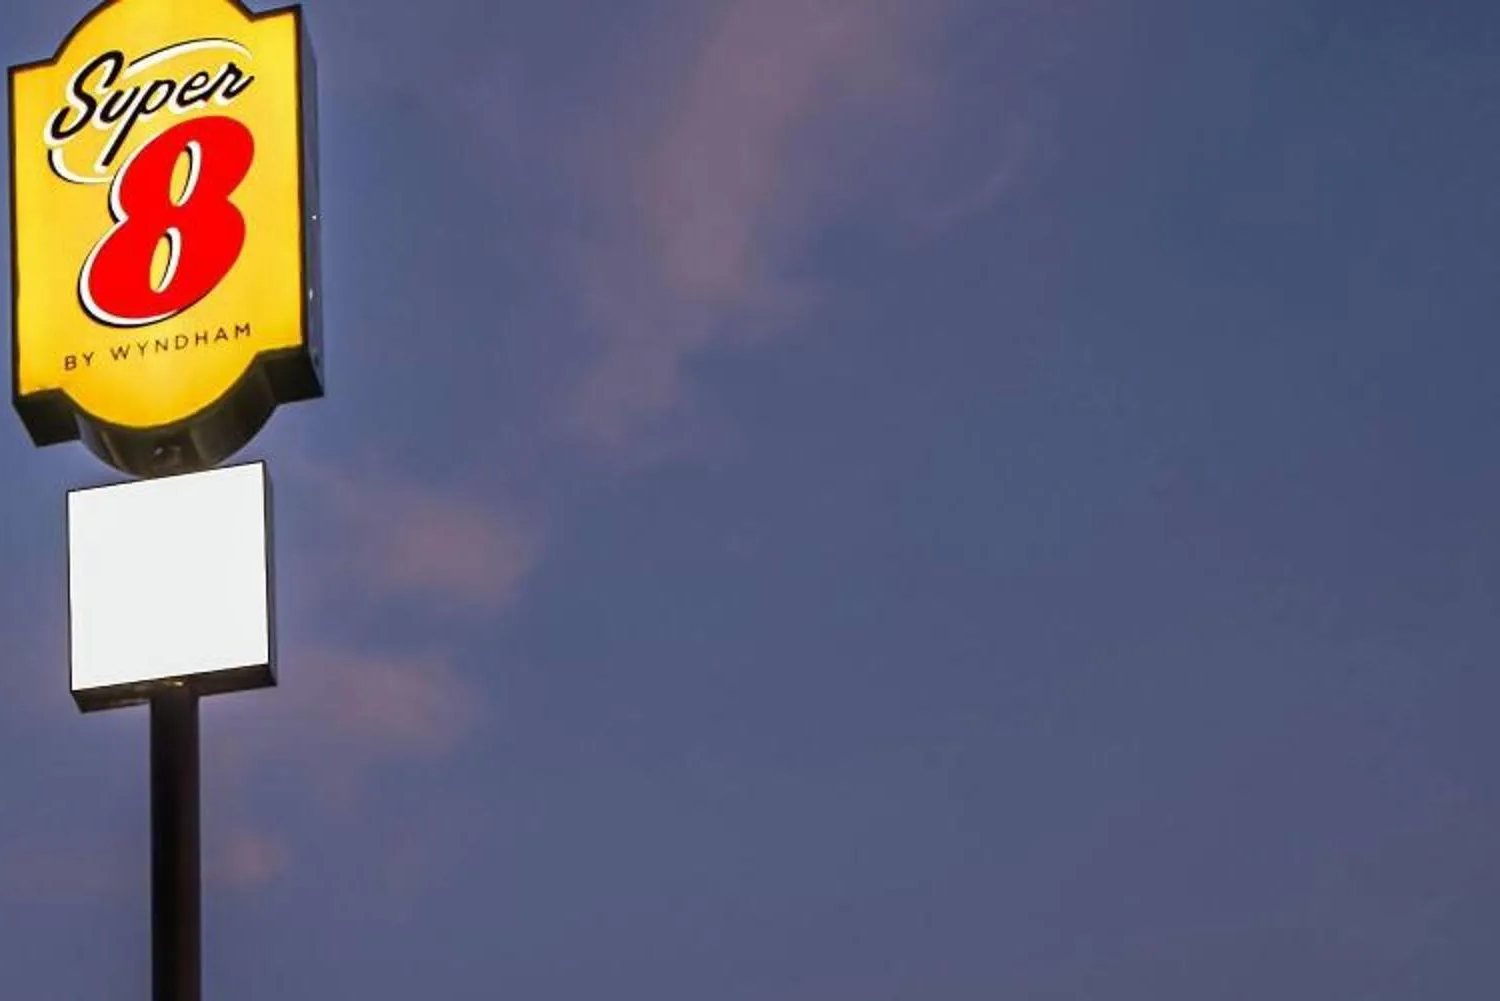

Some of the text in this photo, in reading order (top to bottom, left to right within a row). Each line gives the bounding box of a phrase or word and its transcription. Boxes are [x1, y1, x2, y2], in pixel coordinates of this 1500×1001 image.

[50, 50, 255, 167] Super
[77, 115, 255, 328] 8
[64, 322, 252, 372] BY WYNDHAM
